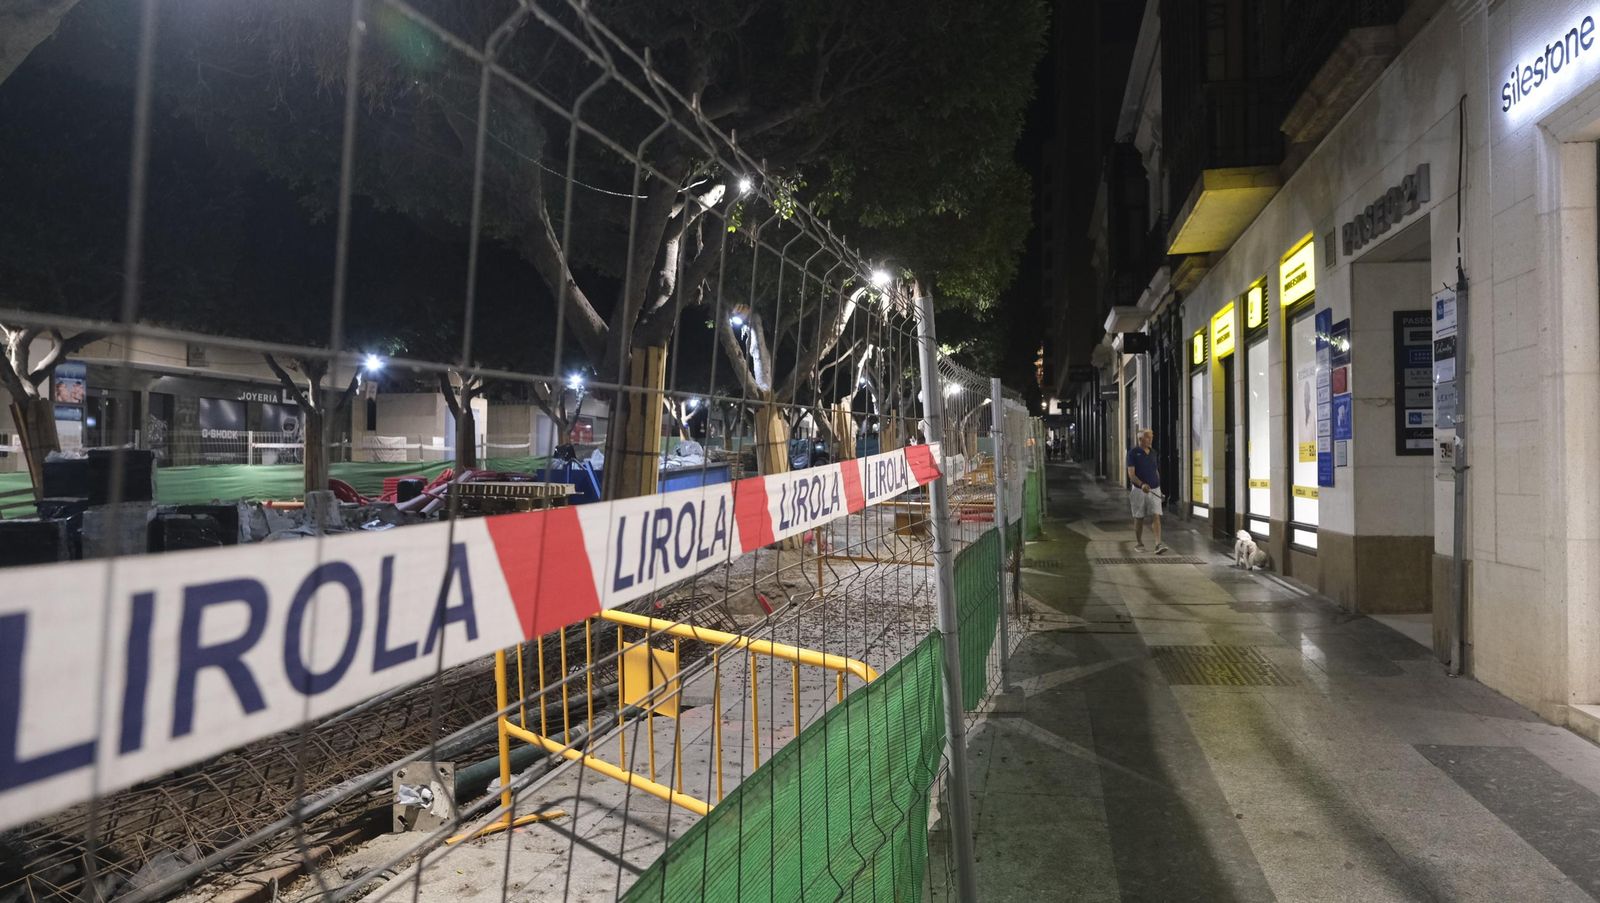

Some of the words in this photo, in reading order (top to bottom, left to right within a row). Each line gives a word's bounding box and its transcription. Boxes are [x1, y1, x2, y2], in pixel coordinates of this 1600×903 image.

[1501, 15, 1595, 112] silestone
[239, 391, 278, 403] JOYERIA
[779, 471, 840, 531] LIROLA
[867, 455, 908, 500] LIROLA
[612, 494, 727, 593] LIROLA
[0, 541, 479, 792] LIROLA
